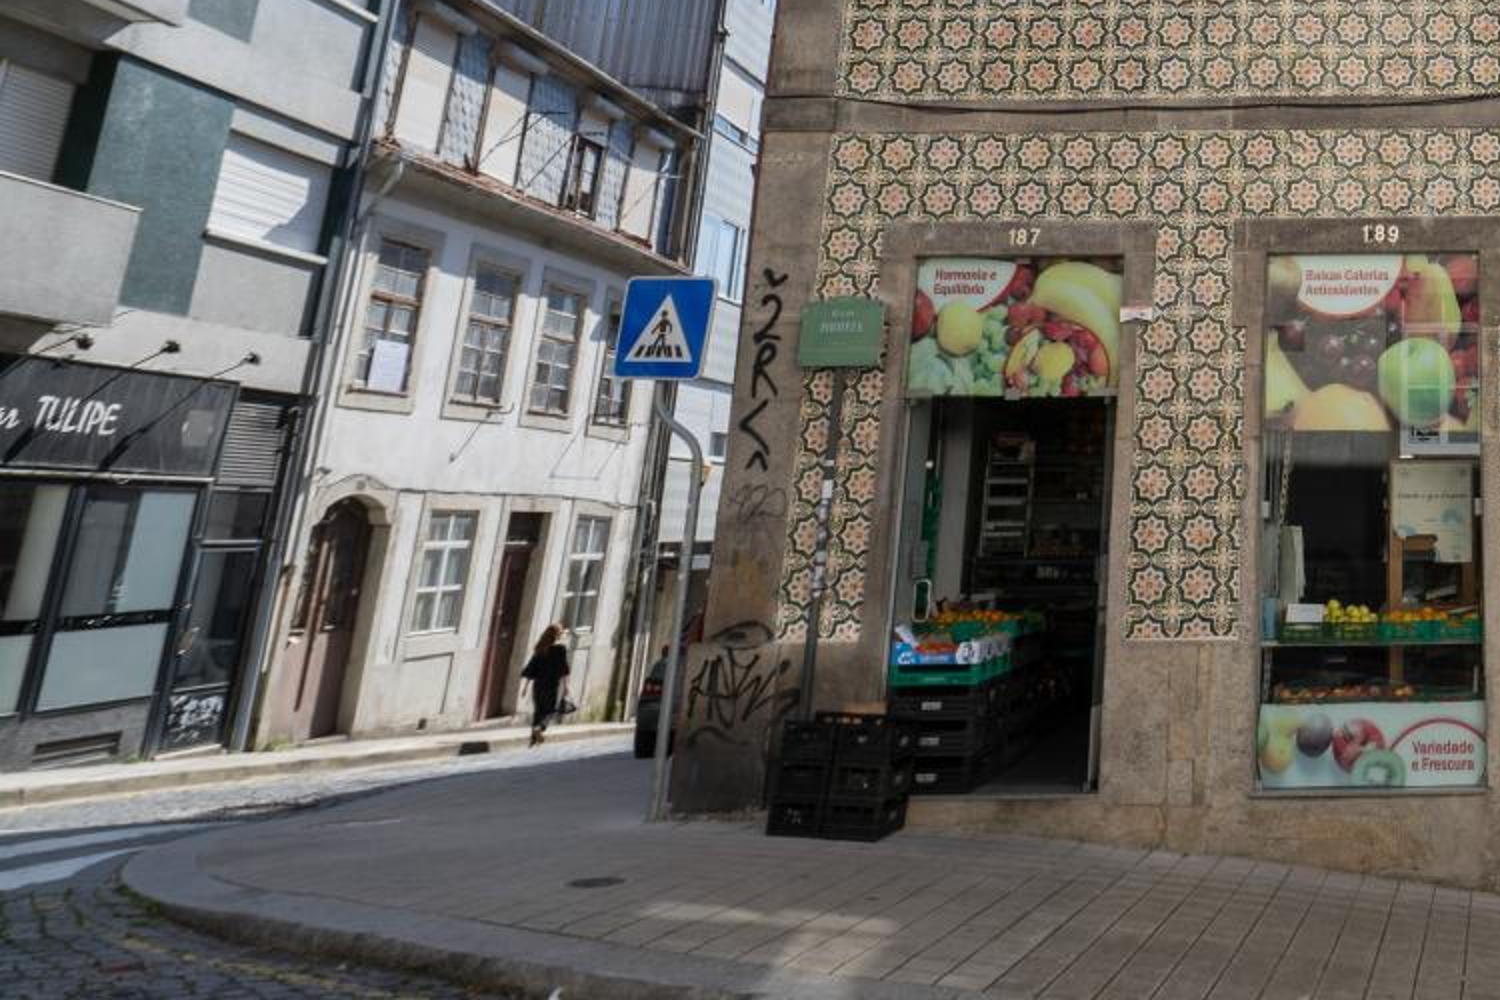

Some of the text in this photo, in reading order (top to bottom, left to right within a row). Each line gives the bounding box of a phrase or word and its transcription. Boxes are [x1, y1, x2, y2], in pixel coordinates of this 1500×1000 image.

[1008, 227, 1041, 247] 187
[1362, 223, 1399, 244] 189
[34, 394, 122, 436] TULIPE
[1411, 739, 1475, 754] Variedade
[1422, 757, 1474, 771] Frescura
